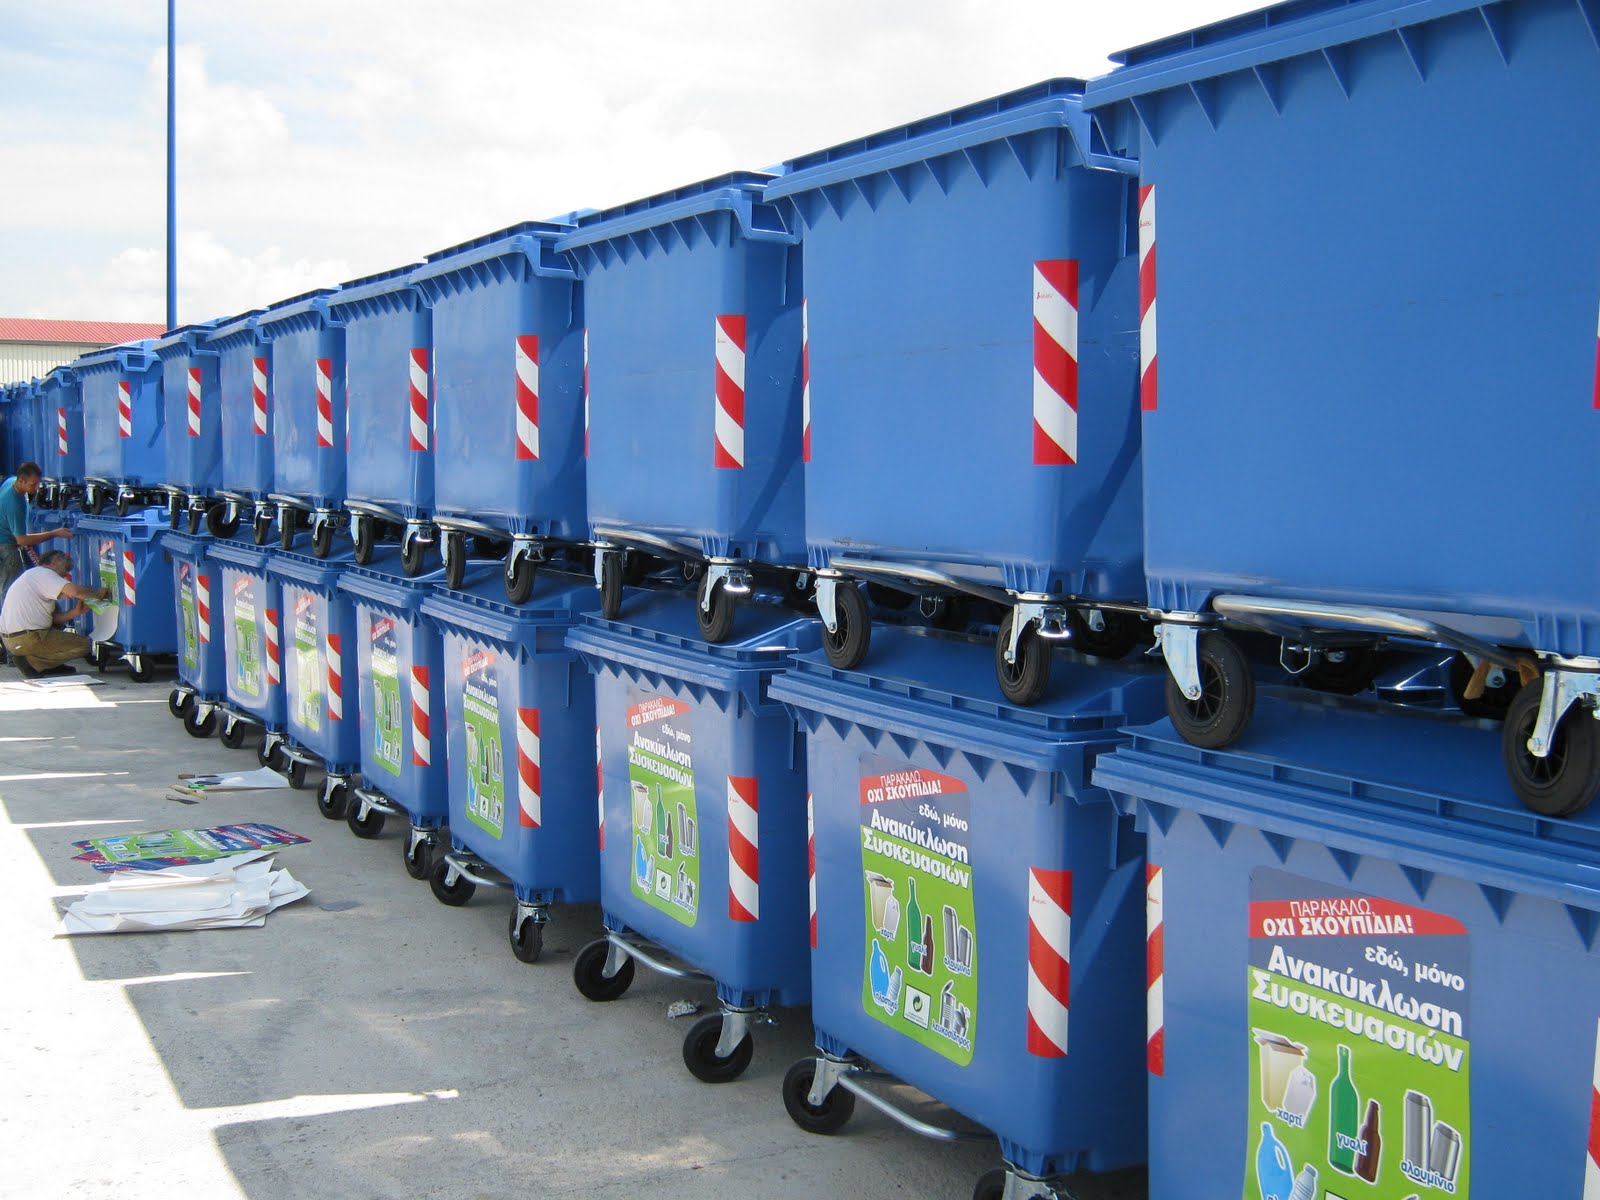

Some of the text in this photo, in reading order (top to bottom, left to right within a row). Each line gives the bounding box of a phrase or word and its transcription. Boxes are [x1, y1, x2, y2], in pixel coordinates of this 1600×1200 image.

[633, 730, 692, 769] Ανακύκλωση
[628, 747, 693, 788] Συσκευασιών
[867, 779, 942, 803] ΟΧΙ ΣΚΟΥΠΙΔΙΑ!
[918, 803, 968, 832] εδώ, μόνο
[870, 808, 968, 864] Ανακύκλωση
[862, 828, 969, 889] Συσκευασιών
[1262, 914, 1415, 936] ΟΧΙ ΣΚΟΥΠΙΔΙΑ!
[1290, 898, 1376, 918] ΠΑΡΑΚΑΛΩ,
[1364, 945, 1465, 991] εδώ, μόνο
[1267, 944, 1463, 1038] Ανακύκλωση
[1252, 969, 1465, 1074] Συσκευασιών
[1276, 1108, 1304, 1128] χαρτί
[1336, 1132, 1368, 1155] γυαλί
[1400, 1161, 1455, 1193] αλουμίνιο
